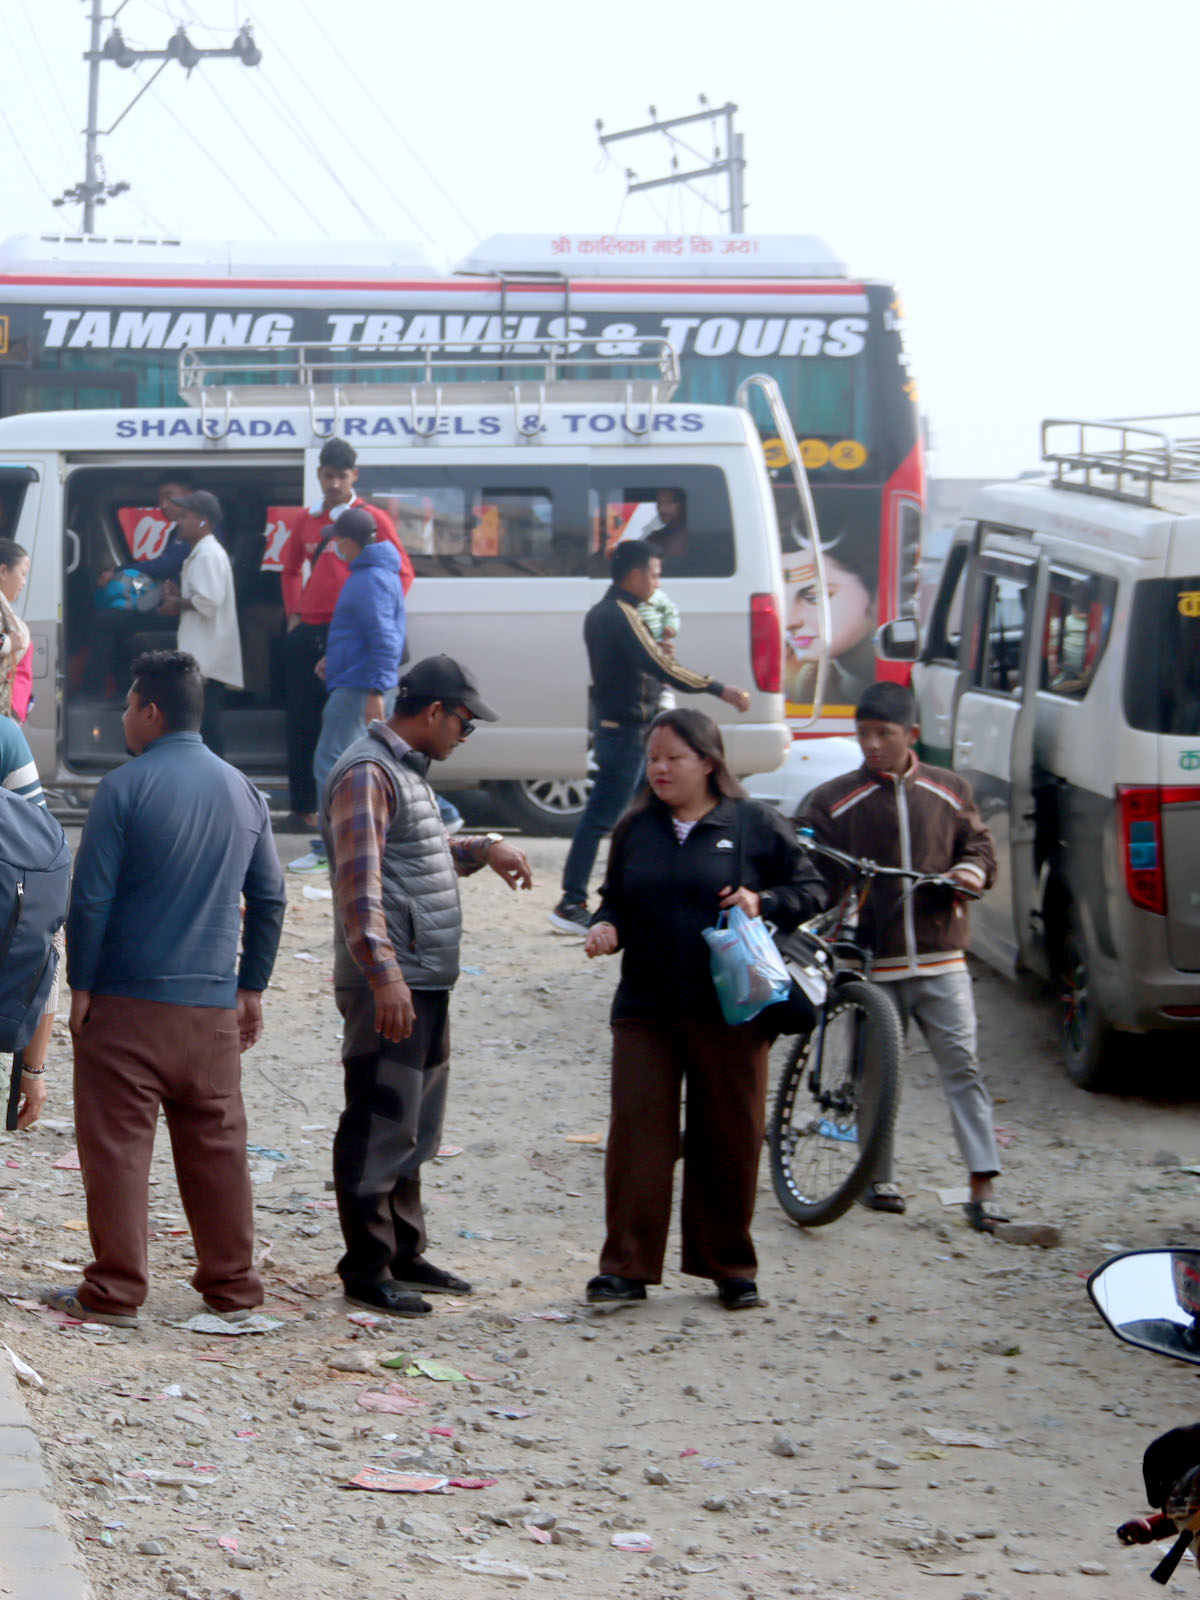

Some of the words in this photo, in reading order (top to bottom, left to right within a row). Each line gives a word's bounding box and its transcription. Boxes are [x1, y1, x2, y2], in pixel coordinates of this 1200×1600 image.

[42, 310, 295, 351] TAMANG
[326, 313, 588, 355] TRAVELS
[594, 323, 642, 357] &
[661, 316, 870, 359] TOURS
[115, 418, 296, 438] SHARADA
[315, 416, 501, 437] TRAVELS
[522, 414, 546, 433] &
[562, 413, 704, 433] TOURS
